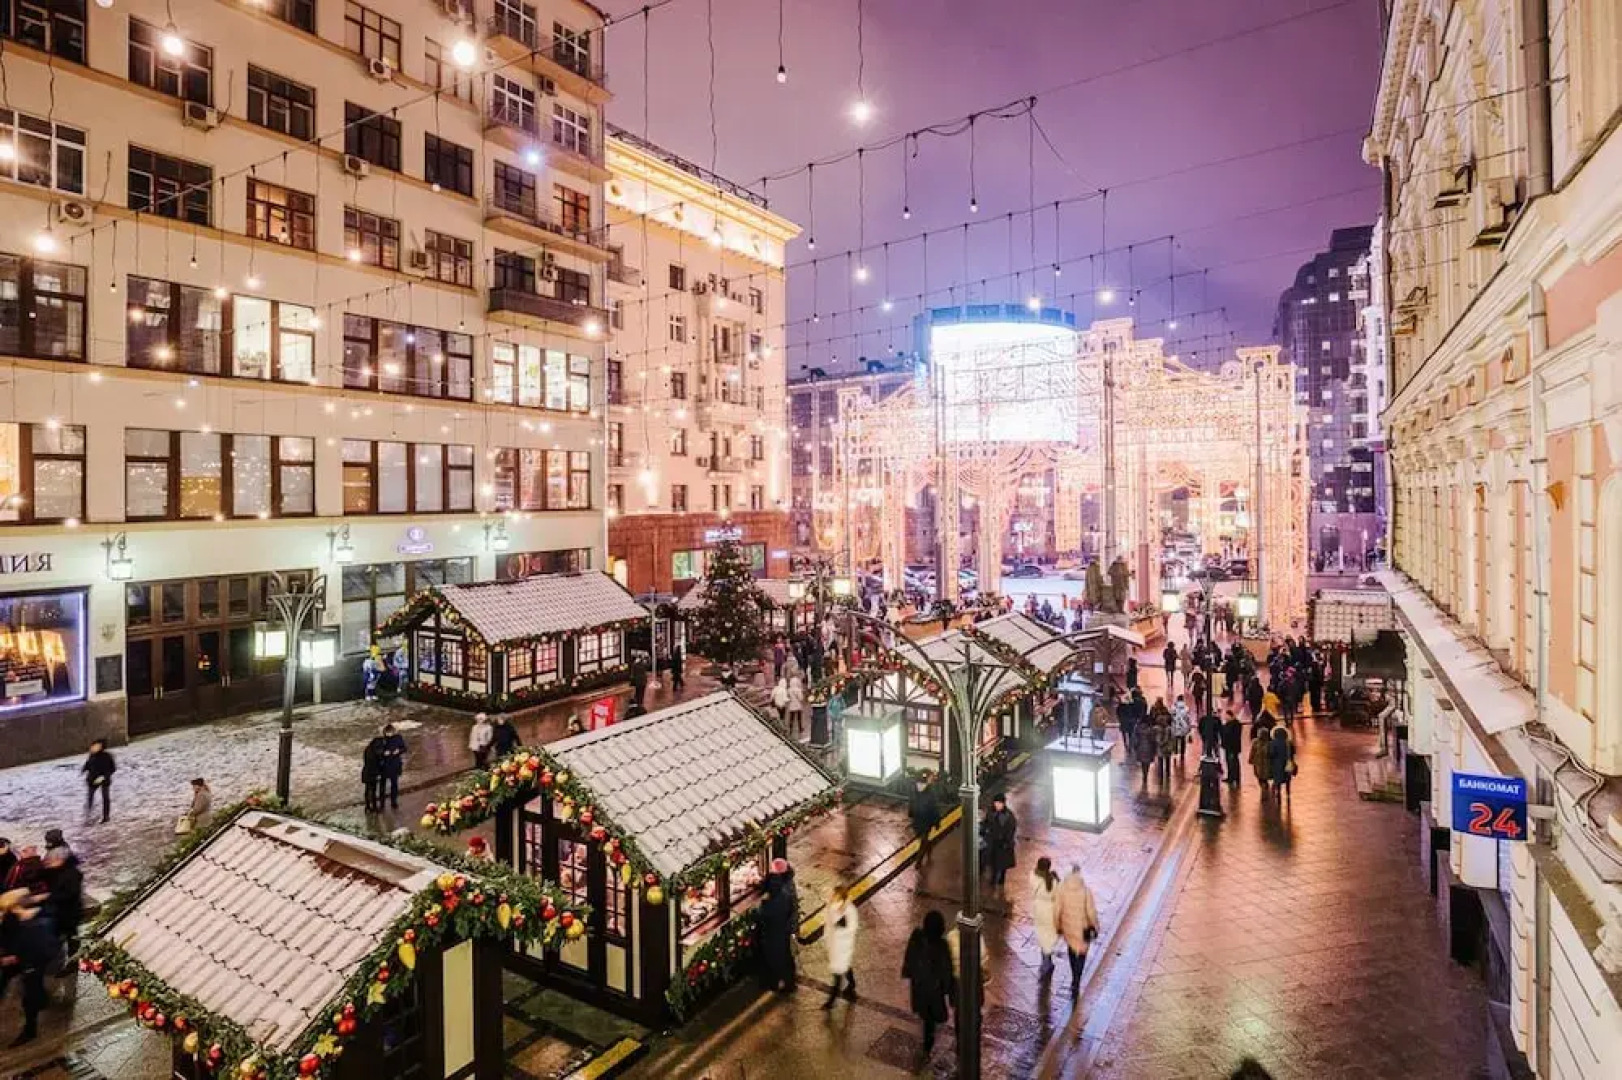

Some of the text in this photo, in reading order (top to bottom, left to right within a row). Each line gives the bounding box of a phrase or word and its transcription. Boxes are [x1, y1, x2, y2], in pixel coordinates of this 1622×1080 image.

[0, 552, 53, 574] ИЯ
[1459, 778, 1521, 795] БАНКОМАТ
[1468, 802, 1521, 838] 24
